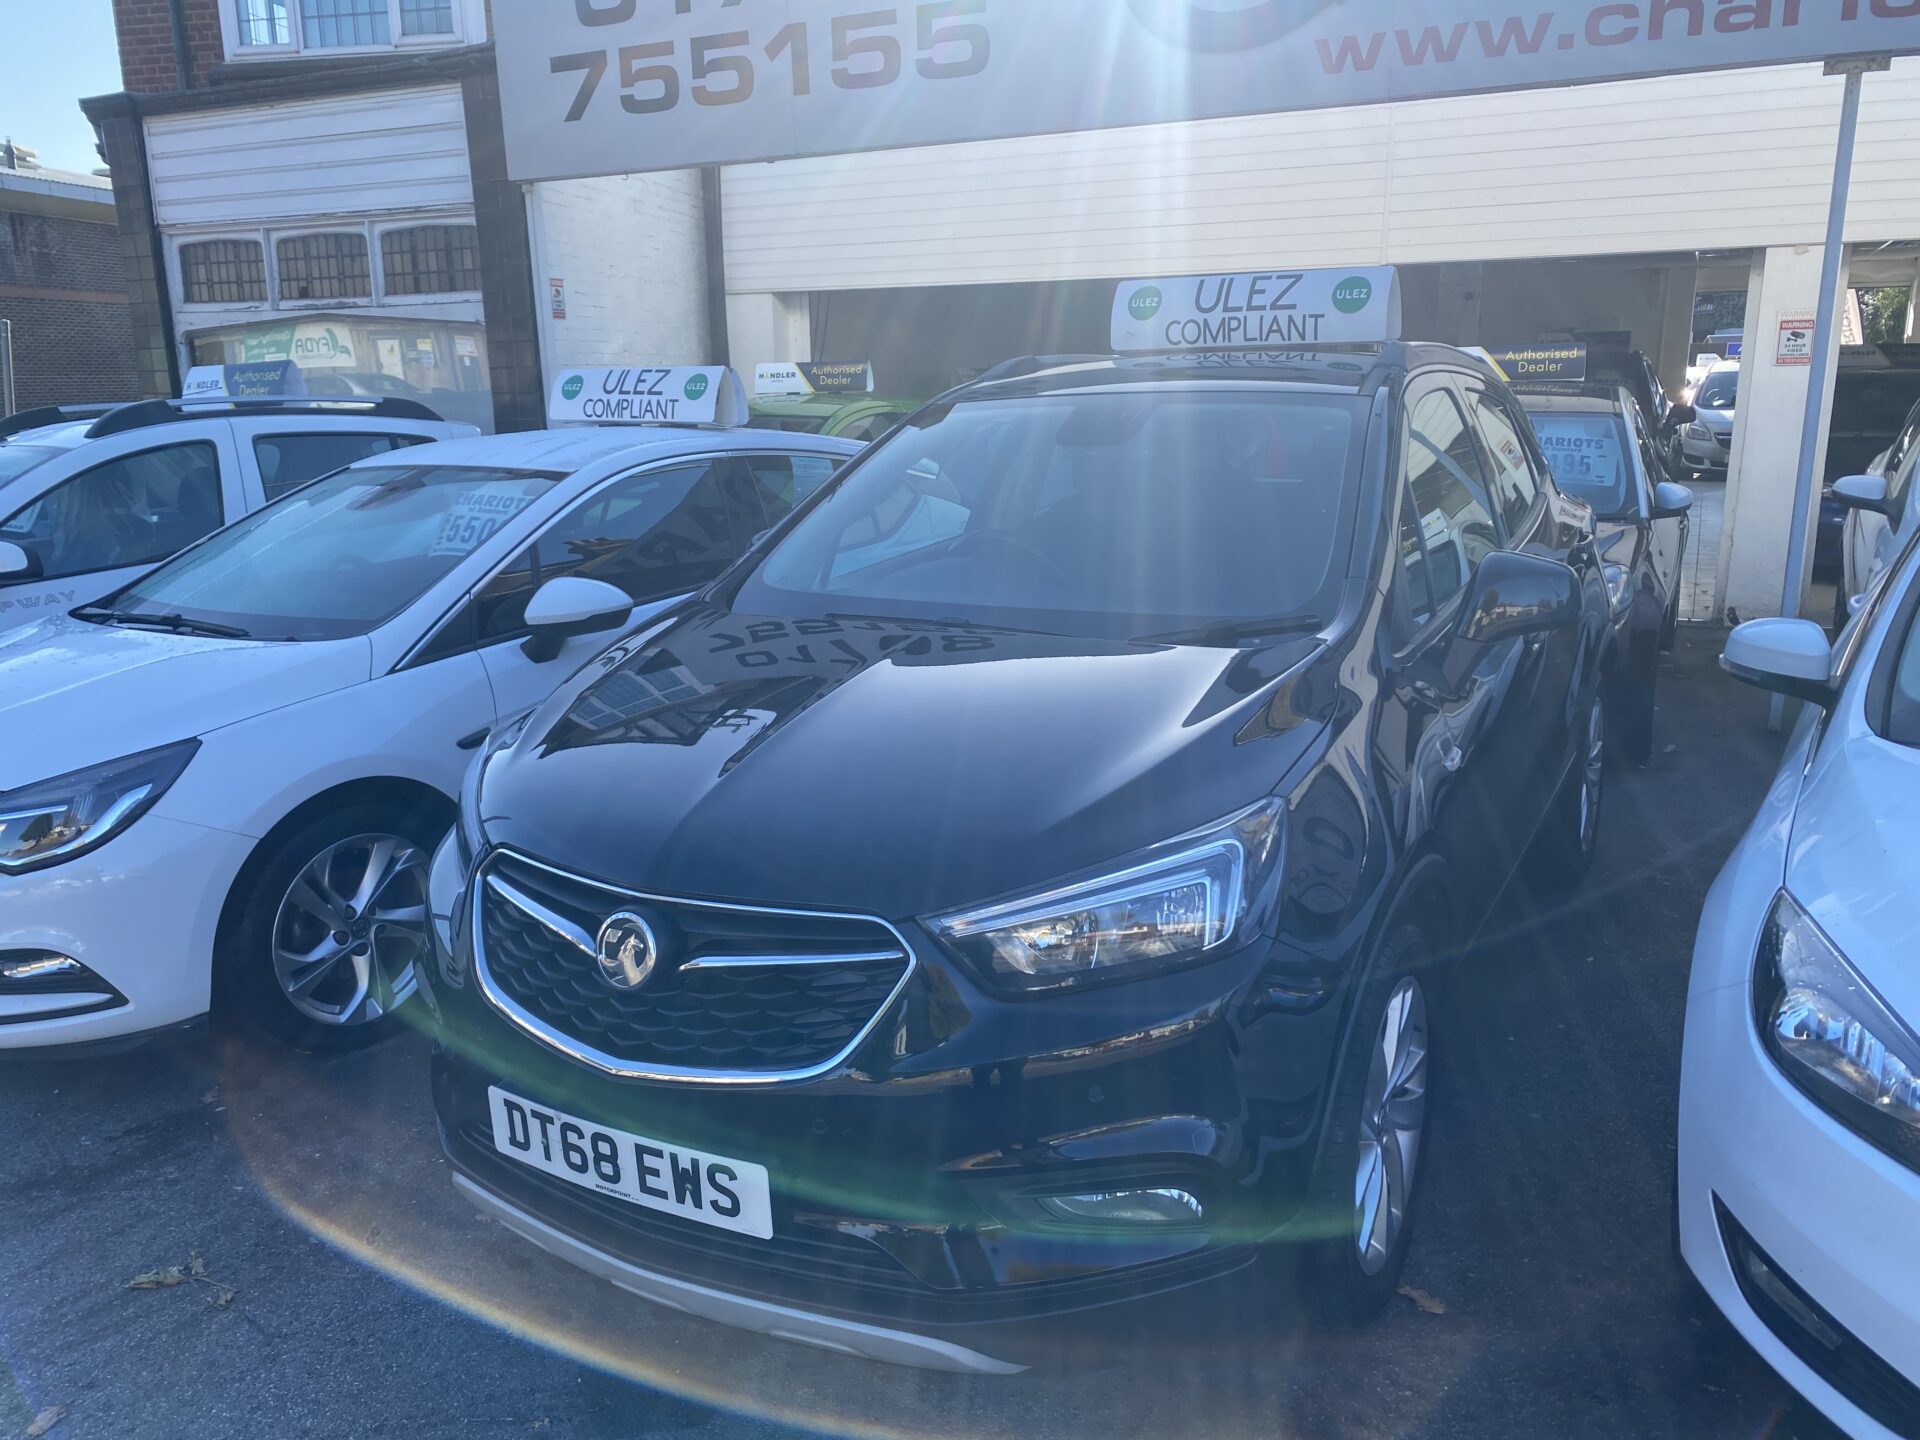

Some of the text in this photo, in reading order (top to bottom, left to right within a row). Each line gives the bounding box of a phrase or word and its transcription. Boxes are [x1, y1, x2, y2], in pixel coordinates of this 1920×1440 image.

[550, 0, 990, 122] 755155
[1195, 274, 1303, 313] ULEZ
[1336, 288, 1368, 299] ULEZ
[1131, 297, 1159, 307] ULEZ
[1165, 314, 1325, 345] COMPLIANT
[1781, 321, 1814, 329] WARNING
[1506, 347, 1577, 360] Authorised
[811, 365, 865, 375] Authorised
[1518, 361, 1562, 373] Dealer
[233, 367, 282, 382] Authorised
[820, 376, 852, 384] Dealer
[603, 369, 672, 395] ULEZ
[686, 382, 706, 390] ULEZ
[239, 383, 269, 396] Dealer
[583, 398, 679, 419] COMPLIANT
[503, 1098, 741, 1218] DT68 EWS
[595, 1184, 631, 1198] MOTORPOINT
